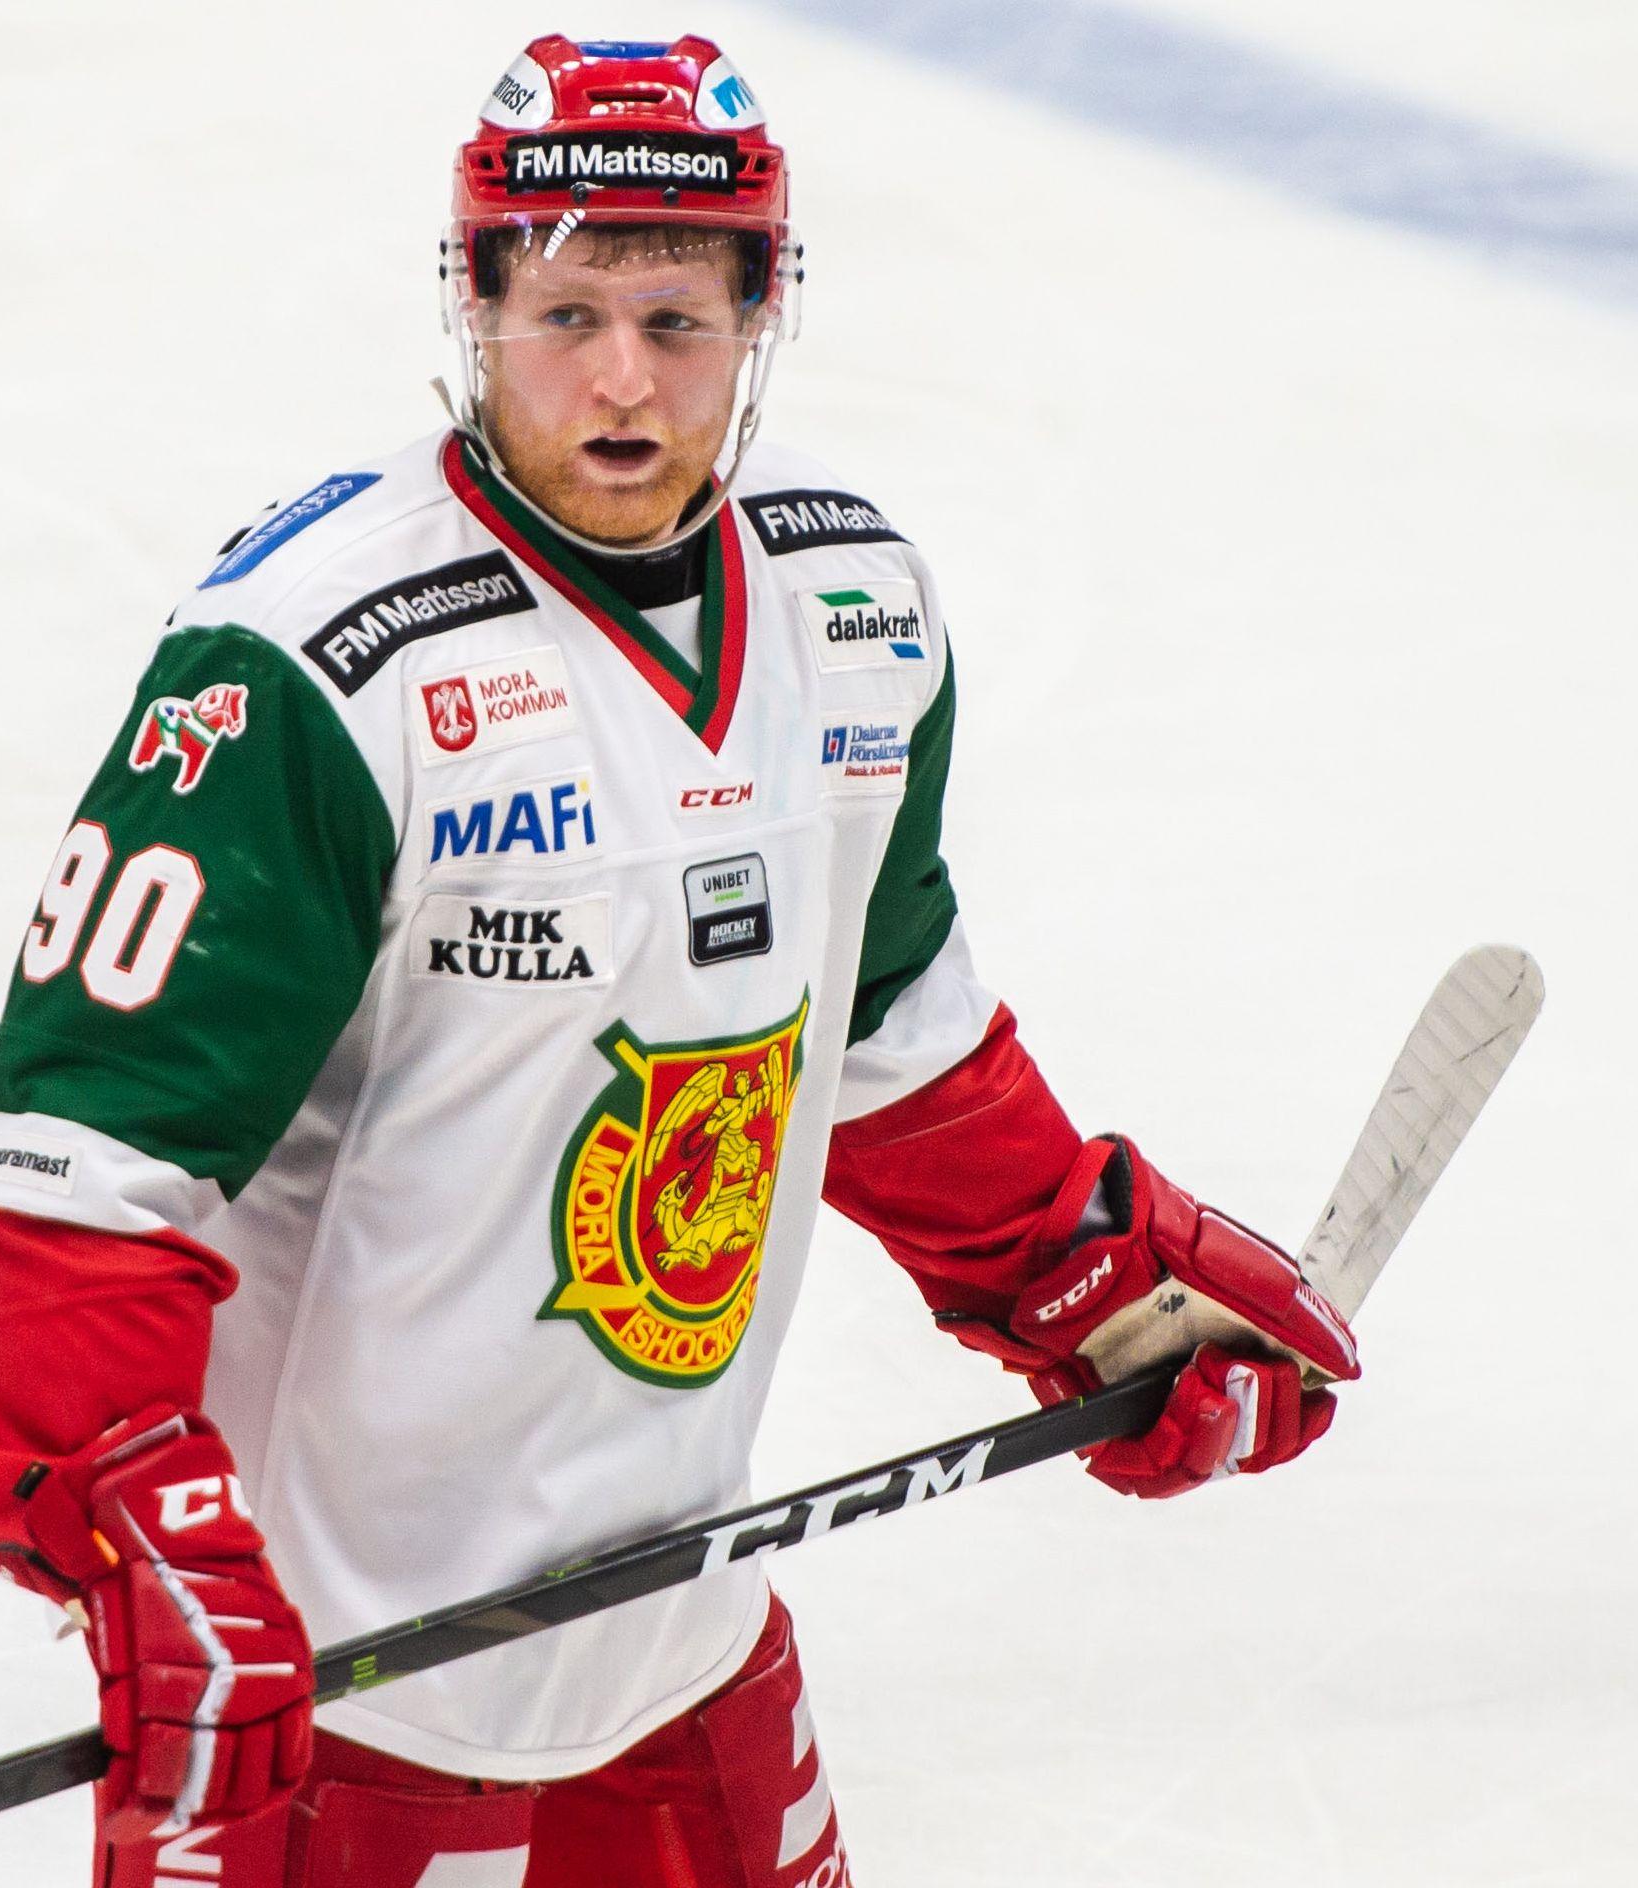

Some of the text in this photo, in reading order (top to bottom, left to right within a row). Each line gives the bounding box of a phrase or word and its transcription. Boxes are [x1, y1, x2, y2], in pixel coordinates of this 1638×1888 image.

[516, 144, 729, 180] FM Mattsson
[759, 501, 820, 539] FM
[323, 572, 519, 675] FM Mattsson
[826, 607, 921, 643] dalakraft
[479, 669, 540, 701] MORA
[485, 687, 569, 725] KOMMUN
[680, 782, 754, 809] CCM
[702, 868, 750, 893] UNIBET
[21, 818, 206, 1012] 90
[468, 906, 564, 944] MIK
[709, 916, 757, 938] HOCKEY
[428, 938, 594, 982] KULLA
[573, 1142, 624, 1277] MORA
[1035, 1253, 1113, 1321] CCM
[700, 1437, 995, 1576] CCM
